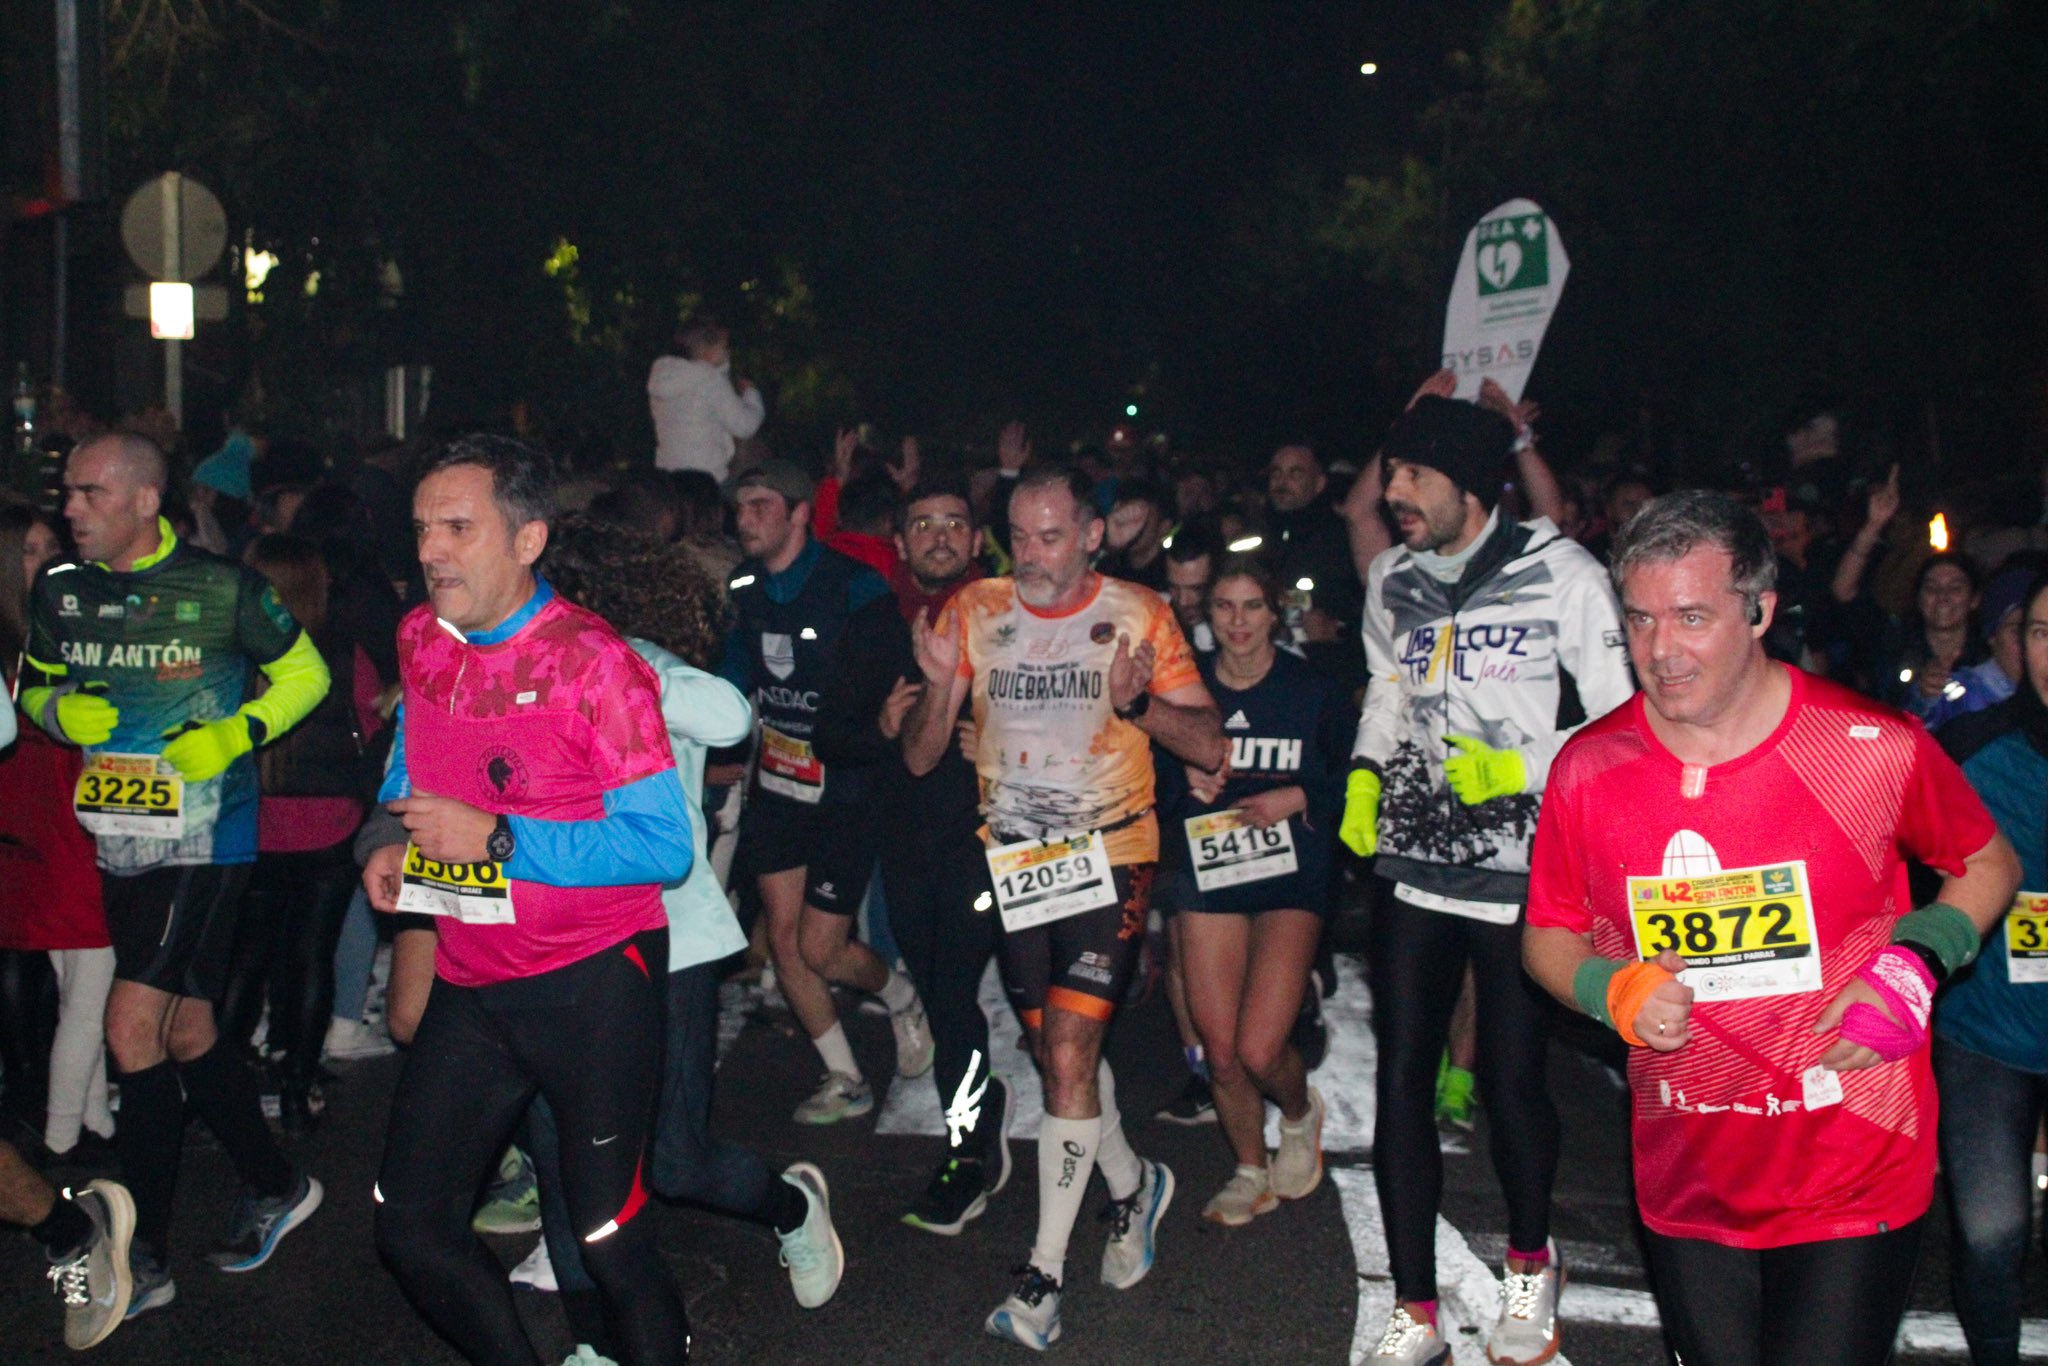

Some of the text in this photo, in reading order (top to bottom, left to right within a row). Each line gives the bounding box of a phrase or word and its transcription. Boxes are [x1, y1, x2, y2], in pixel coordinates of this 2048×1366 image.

[60, 638, 202, 669] SAN ANTÓN
[1398, 623, 1530, 664] JABALCUZ
[987, 668, 1102, 701] QUIEBRAJANO
[1230, 736, 1303, 771] UTH
[83, 775, 171, 807] 3225
[1200, 824, 1282, 861] 5416
[1000, 855, 1093, 898] 12059
[1661, 881, 1694, 903] 42
[1647, 902, 1797, 955] 3872
[1057, 1157, 1077, 1189] asics
